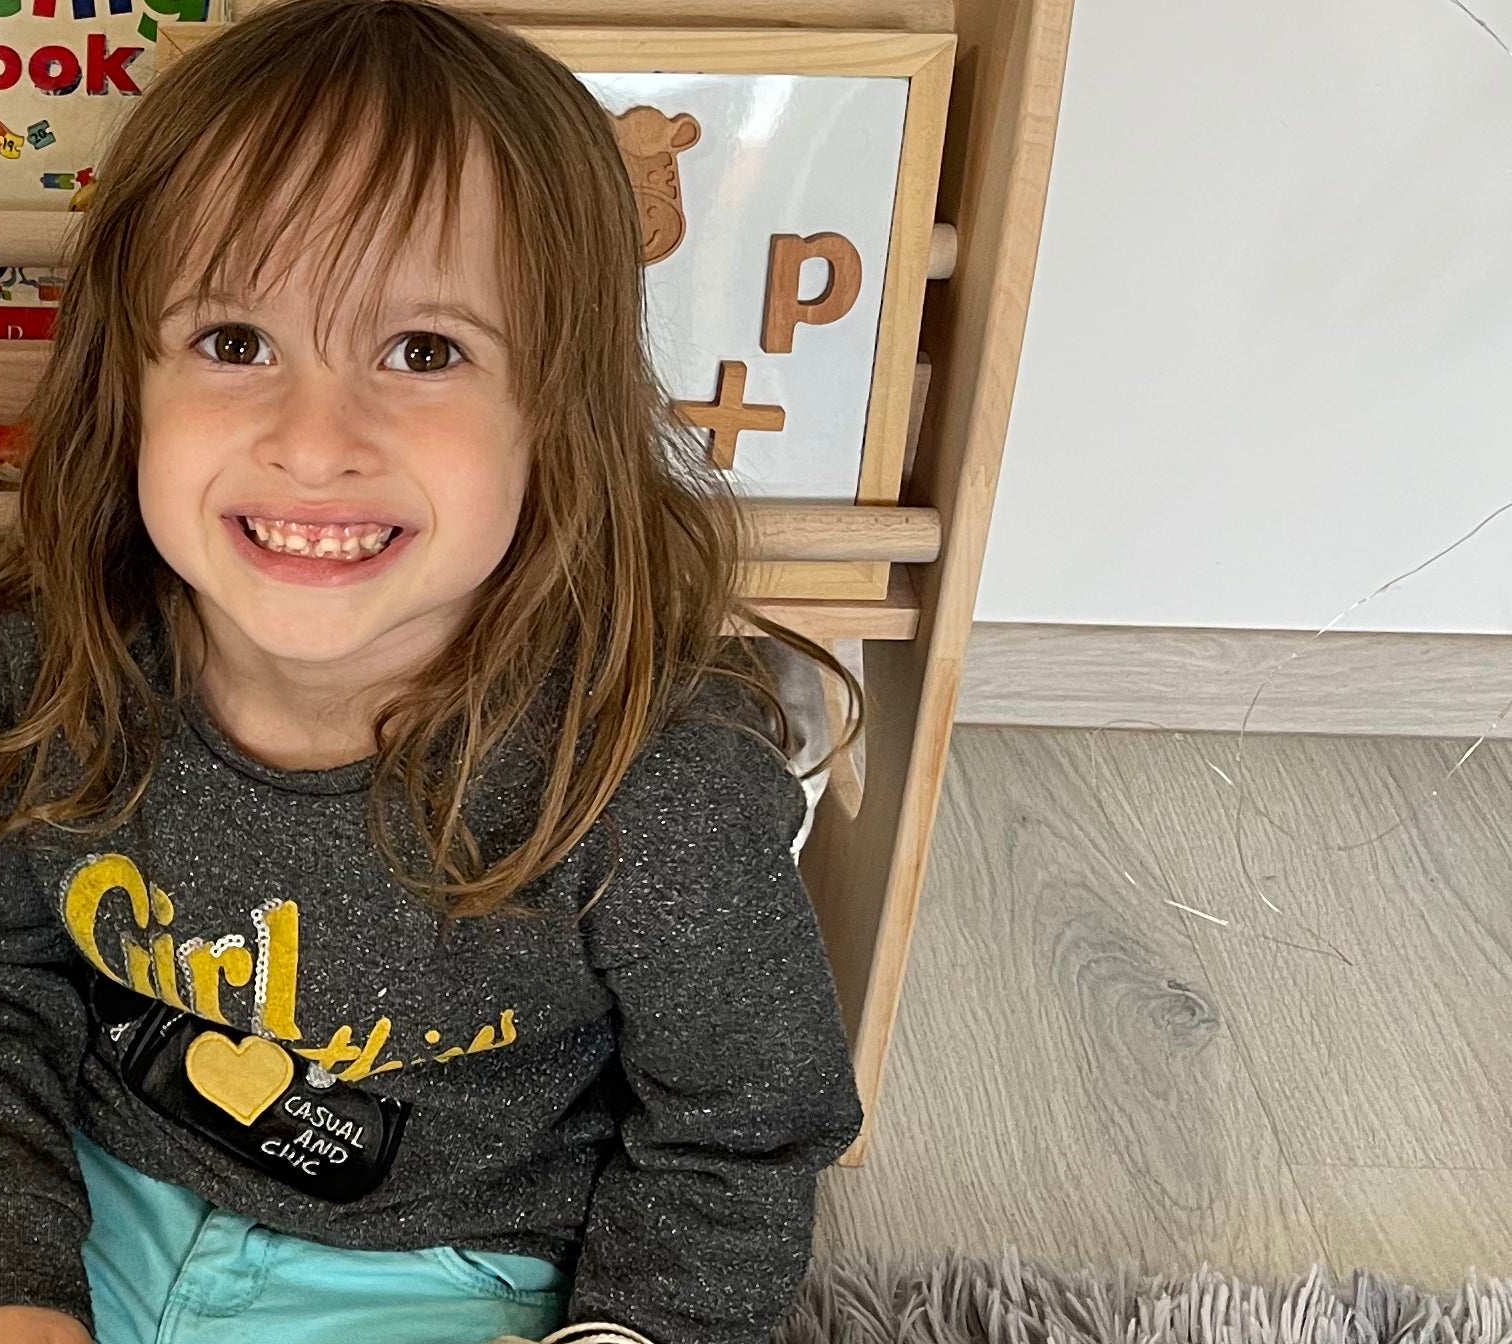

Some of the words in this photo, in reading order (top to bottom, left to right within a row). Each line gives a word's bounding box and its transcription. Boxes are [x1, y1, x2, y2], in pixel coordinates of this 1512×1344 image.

[1, 137, 15, 152] 19
[30, 128, 48, 144] 20
[59, 852, 302, 1041] Girl
[283, 1095, 366, 1149] CASUAL
[293, 1128, 348, 1165] AND
